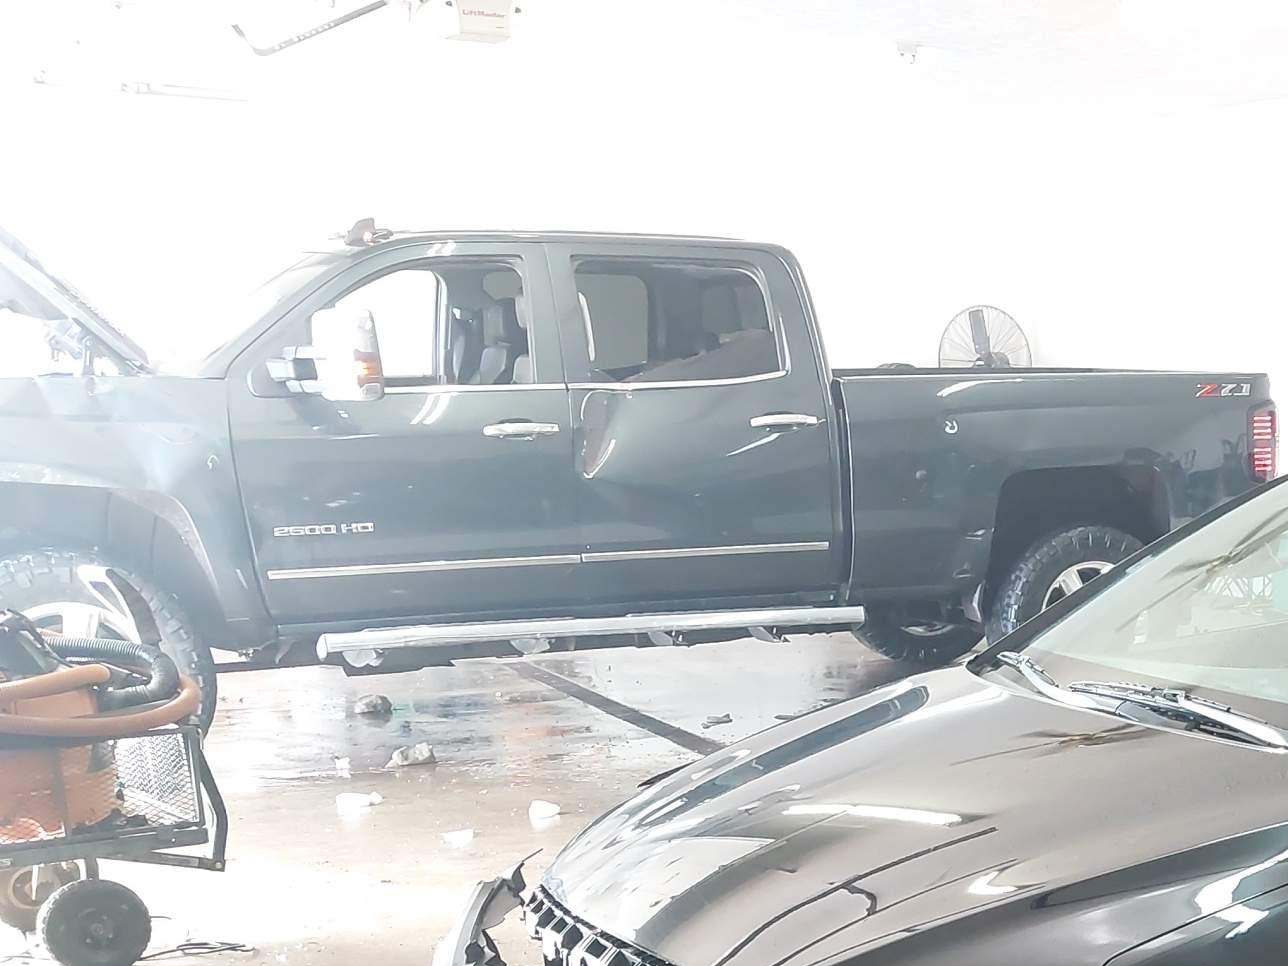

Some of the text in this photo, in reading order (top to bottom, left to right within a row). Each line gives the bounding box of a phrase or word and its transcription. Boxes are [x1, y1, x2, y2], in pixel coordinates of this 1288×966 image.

[1195, 383, 1251, 397] Z71
[273, 522, 375, 537] 2500 HD
